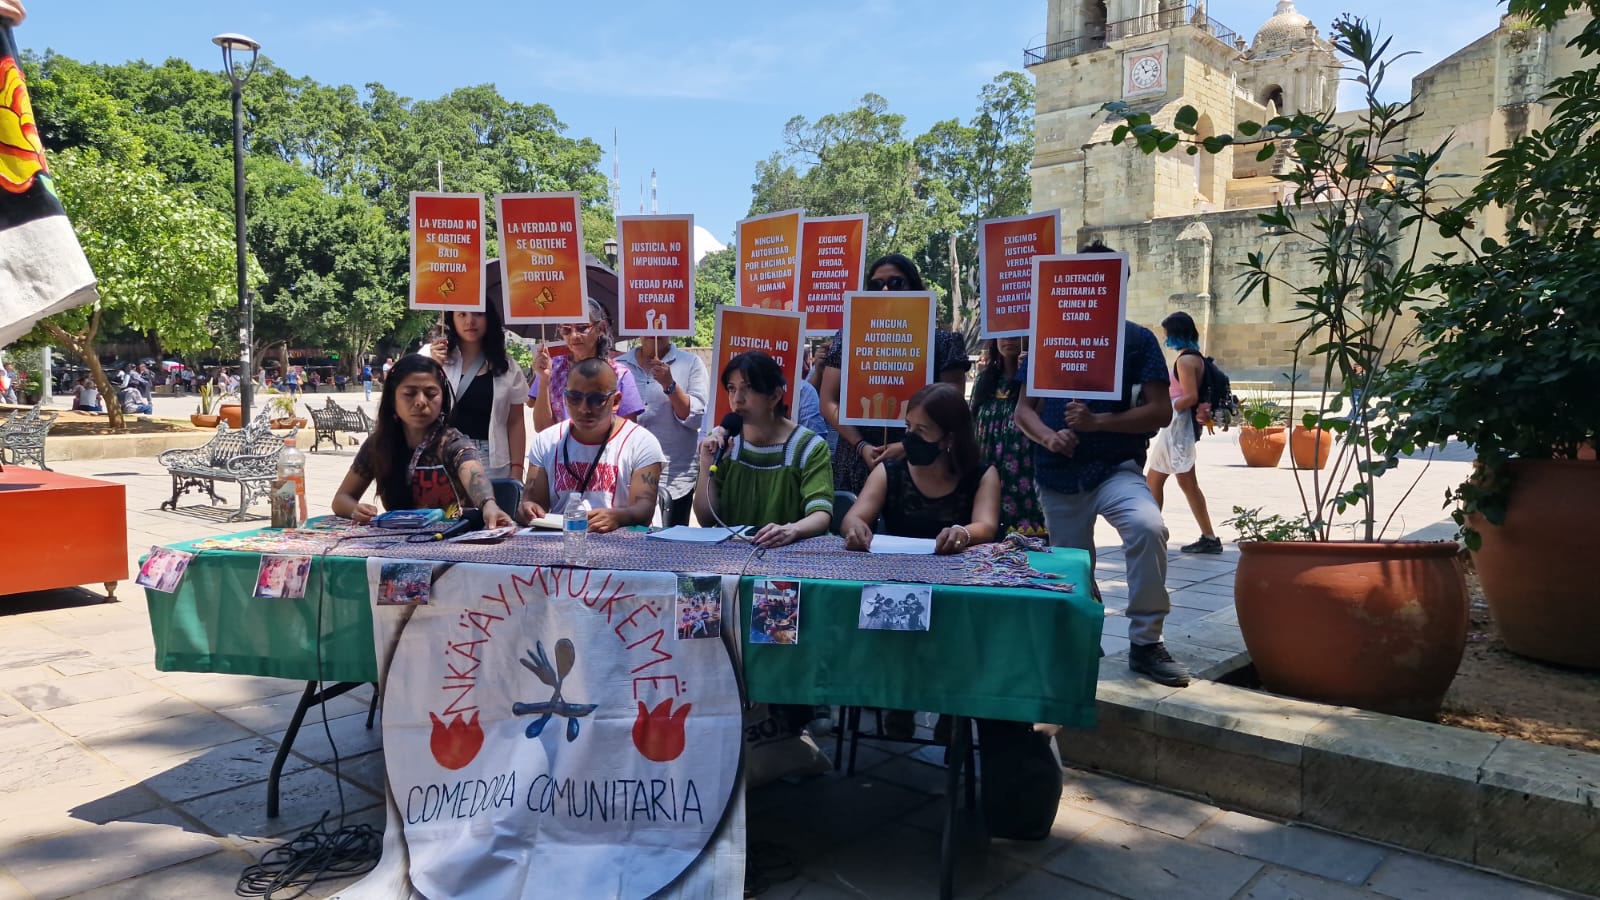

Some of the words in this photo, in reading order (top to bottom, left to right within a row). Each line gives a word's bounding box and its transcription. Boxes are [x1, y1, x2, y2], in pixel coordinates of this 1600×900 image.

[419, 218, 430, 228] LA
[432, 218, 464, 229] VERDAD
[466, 220, 477, 229] NO
[508, 223, 519, 234] LA
[521, 222, 558, 233] VERDAD
[560, 221, 573, 232] NO
[426, 233, 436, 243] SE
[438, 233, 471, 244] OBTIENE
[516, 239, 528, 250] SE
[530, 238, 567, 249] OBTIENE
[754, 235, 784, 246] NINGUNA
[818, 235, 847, 244] EXIGIMOS
[1004, 233, 1037, 244] EXIGIMOS
[438, 248, 459, 258] BAJO
[631, 242, 668, 253] JUSTICIA,
[670, 242, 681, 252] NO
[751, 246, 789, 258] AUTORIDAD
[818, 247, 845, 256] JUSTICIA,
[1004, 245, 1037, 256] JUSTICIA,
[531, 255, 554, 266] BAJO
[632, 256, 680, 267] IMPUNIDAD.
[745, 261, 759, 270] POR
[761, 258, 786, 269] ENCIMA
[788, 256, 796, 265] DE
[819, 259, 844, 268] VERDAD,
[1006, 257, 1032, 267] VERDAD
[430, 263, 467, 273] TORTURA
[811, 268, 849, 279] REPARACIÓN
[523, 271, 565, 282] TORTURA
[750, 272, 758, 282] LA
[760, 269, 792, 281] DIGNIDAD
[999, 269, 1032, 280] REPARAC
[1054, 274, 1063, 283] LA
[1065, 272, 1104, 283] DETENCIÓN
[629, 279, 660, 289] VERDAD
[662, 279, 684, 289] PARA
[757, 281, 786, 293] HUMANA
[813, 282, 840, 290] INTEGRAL
[1002, 281, 1031, 291] INTEGRA
[808, 292, 840, 302] GARANTÍAS
[997, 291, 1031, 303] GARANTÍA
[1051, 287, 1095, 296] ARBITRARIA
[1097, 287, 1107, 295] ES
[638, 293, 675, 304] REPARAR
[1058, 300, 1086, 308] CRIMEN
[1088, 300, 1098, 308] DE
[816, 304, 845, 312] REPETICI
[996, 306, 1006, 315] NO
[1007, 305, 1031, 314] REPETI
[1062, 312, 1092, 321] ESTADO.
[870, 319, 907, 329] NINGUNA
[865, 333, 913, 343] AUTORIDAD
[1043, 337, 1078, 347] ¡JUSTICIA,
[1080, 338, 1090, 346] NO
[1092, 336, 1109, 346] MÁS
[729, 336, 772, 351] JUSTICIA,
[775, 341, 789, 352] NO
[856, 347, 873, 357] POR
[876, 347, 907, 357] ENCIMA
[909, 347, 921, 357] DE
[1055, 350, 1083, 359] ABUSOS
[1085, 350, 1095, 359] DE
[860, 361, 871, 371] LA
[873, 361, 914, 372] DIGNIDAD
[1061, 362, 1088, 372] PODER!
[869, 375, 904, 385] HUMANA
[407, 771, 516, 825] COMEDORA
[527, 774, 703, 824] COMUNITARIA
